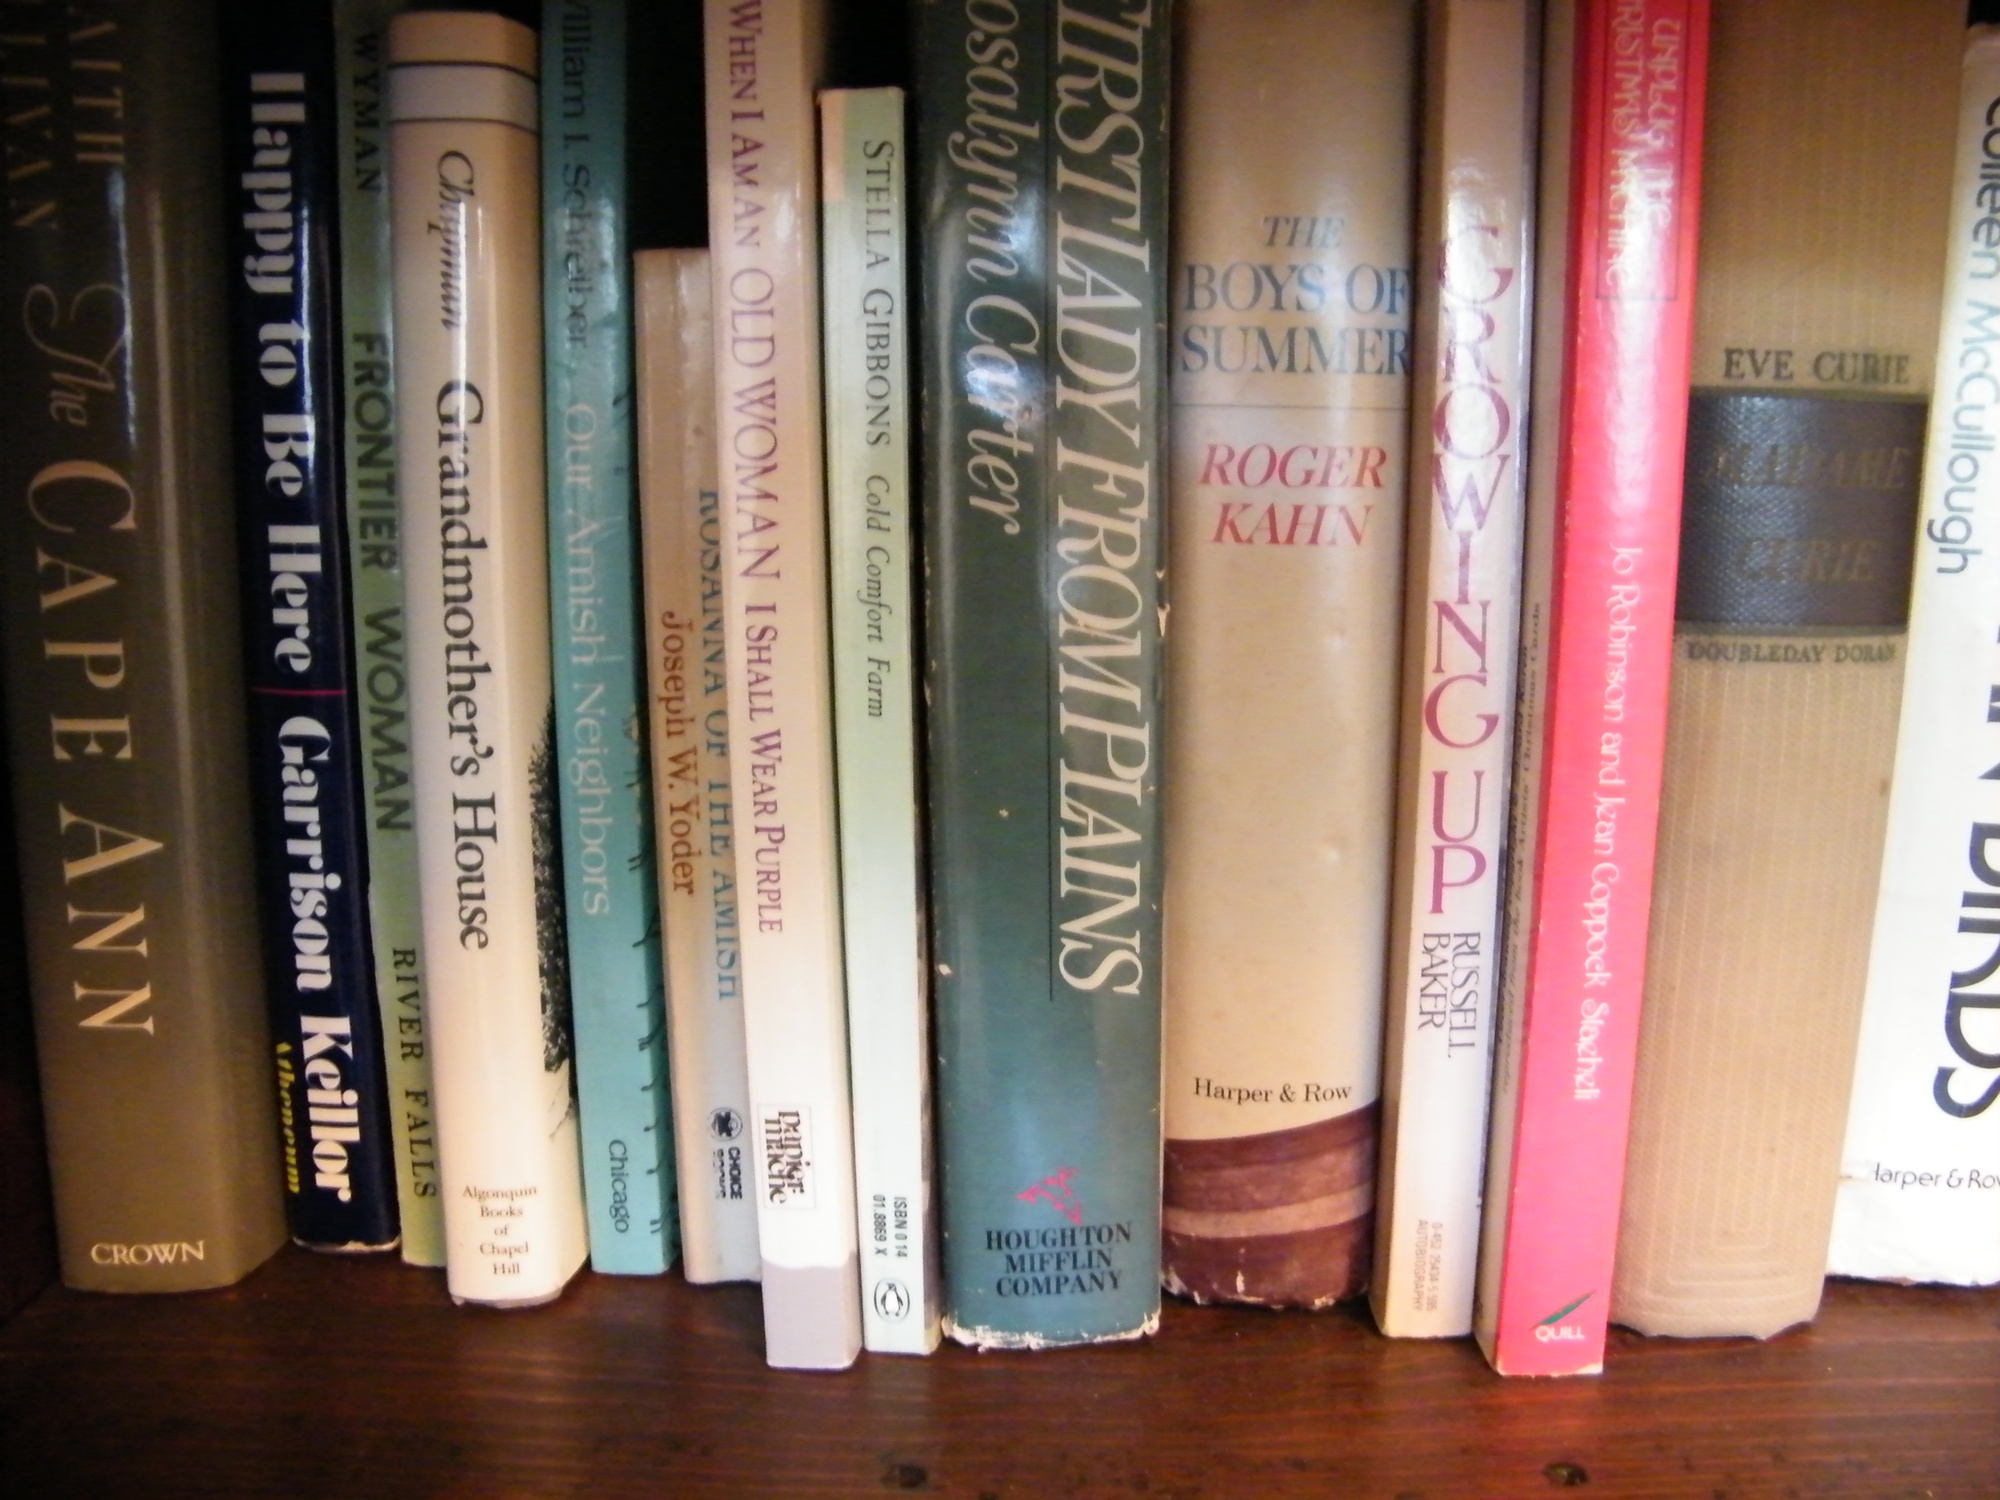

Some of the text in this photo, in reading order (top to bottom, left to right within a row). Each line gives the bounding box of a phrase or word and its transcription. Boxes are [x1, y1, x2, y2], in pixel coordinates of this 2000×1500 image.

[352, 31, 381, 192] WYMAN
[1263, 215, 1345, 248] THE
[861, 139, 895, 448] STELLA GIBBONS
[1184, 263, 1410, 314] BOYS OF
[1055, 211, 1150, 448] LADY
[1181, 326, 1410, 375] SUMMER
[241, 72, 323, 673] Happy to Be Here
[1723, 348, 1910, 384] EVE CURIE
[966, 293, 1042, 537] Carter
[1928, 298, 2000, 575] McCullough
[729, 0, 787, 933] WHEN I AM AN OLD WOMAN I SHALL WEAR PURPLE
[1200, 444, 1387, 489] ROGER
[1210, 503, 1373, 546] KAHN
[352, 333, 412, 832] FRONTIER WOMAN
[1056, 438, 1150, 711] FROM
[1609, 542, 1643, 575] Jo
[857, 473, 892, 719] Cold Comfort Farm
[23, 283, 165, 1036] The CAPE ANN
[436, 378, 498, 950] Grandmother's House
[563, 403, 613, 917] Our Amish Neighbors
[1603, 581, 1641, 722] Robinson
[1687, 640, 1825, 665] DOUBLEDAY
[661, 609, 703, 896] Joseph W. Yoder
[1598, 731, 1626, 786] and
[1058, 705, 1150, 995] PLAINS
[1428, 770, 1488, 914] UP
[1593, 791, 1626, 855] Jean
[1581, 862, 1619, 989] Coppock
[277, 717, 361, 1204] Garrison Keillor
[1418, 932, 1450, 1030] BAKER
[1447, 931, 1482, 1058] RUSSELL
[392, 948, 437, 1199] RIVER FALLS
[1194, 1077, 1352, 1106] Harper & Row
[461, 1184, 538, 1204] Algonquin
[607, 1139, 629, 1235] Chicago
[728, 1147, 743, 1201] CHOICE
[1947, 1169, 1963, 1188] &
[479, 1205, 524, 1219] Books
[494, 1223, 510, 1238] of
[894, 1196, 908, 1258] ISBN 0 14
[986, 1221, 1133, 1250] HOUGHTON
[91, 1240, 204, 1266] CROWN
[479, 1241, 530, 1259] Chapel
[492, 1261, 521, 1277] Hill
[875, 1247, 887, 1256] X
[1005, 1248, 1113, 1273] MIFFLIN
[1413, 1220, 1429, 1311] AUTOBIOGRAPHY
[995, 1270, 1123, 1298] COMPANY
[1535, 1325, 1586, 1341] QUILL
